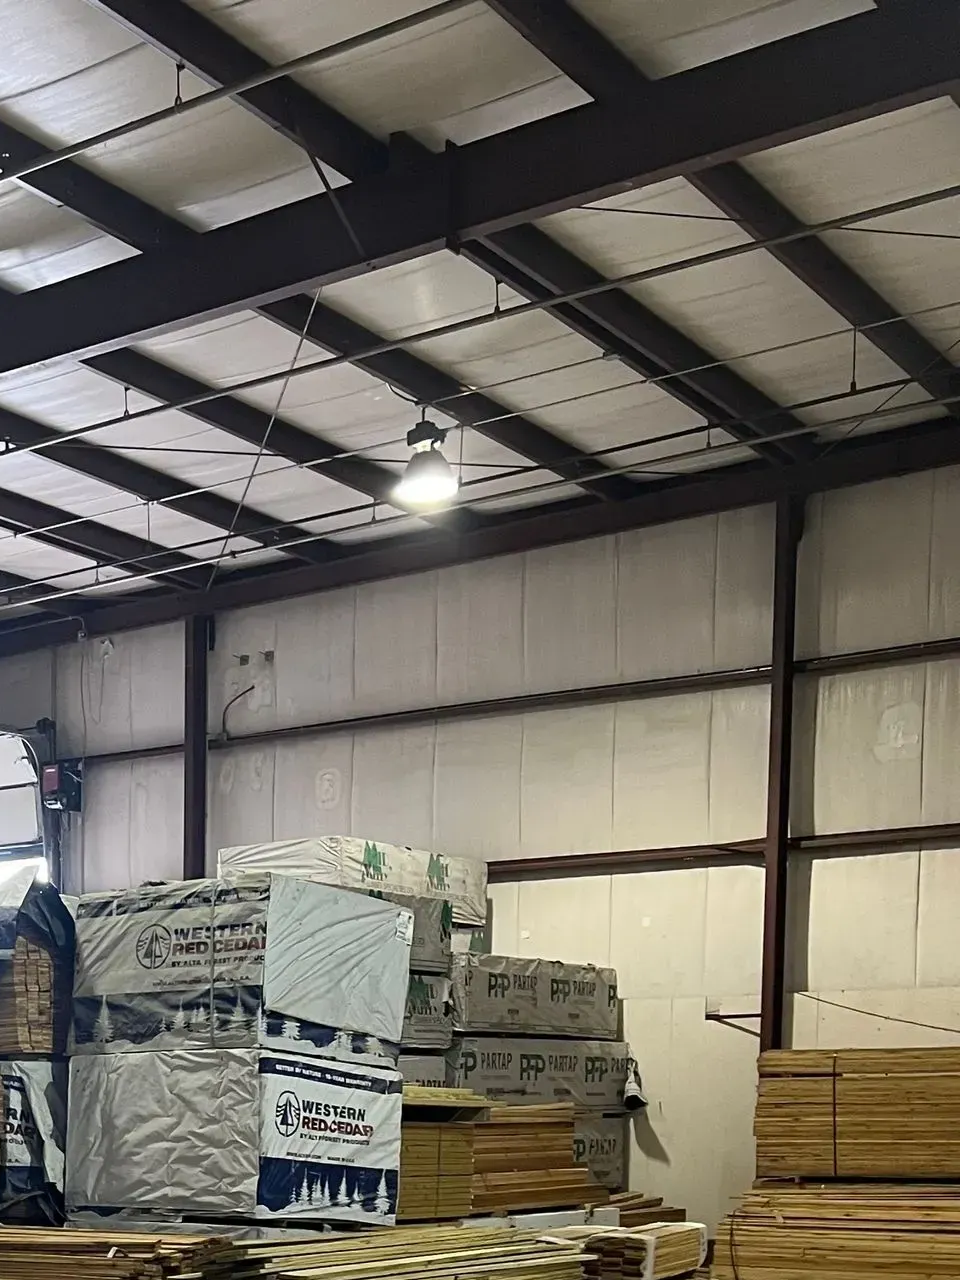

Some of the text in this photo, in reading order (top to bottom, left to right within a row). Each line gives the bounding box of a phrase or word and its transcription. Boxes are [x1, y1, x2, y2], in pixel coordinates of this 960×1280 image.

[174, 921, 267, 940] WESTERN
[172, 942, 209, 956] RED
[481, 1053, 512, 1070] PARTAP
[548, 1055, 578, 1073] PARTAP
[302, 1100, 366, 1122] WESTERN
[302, 1116, 374, 1138] RED CEDAR
